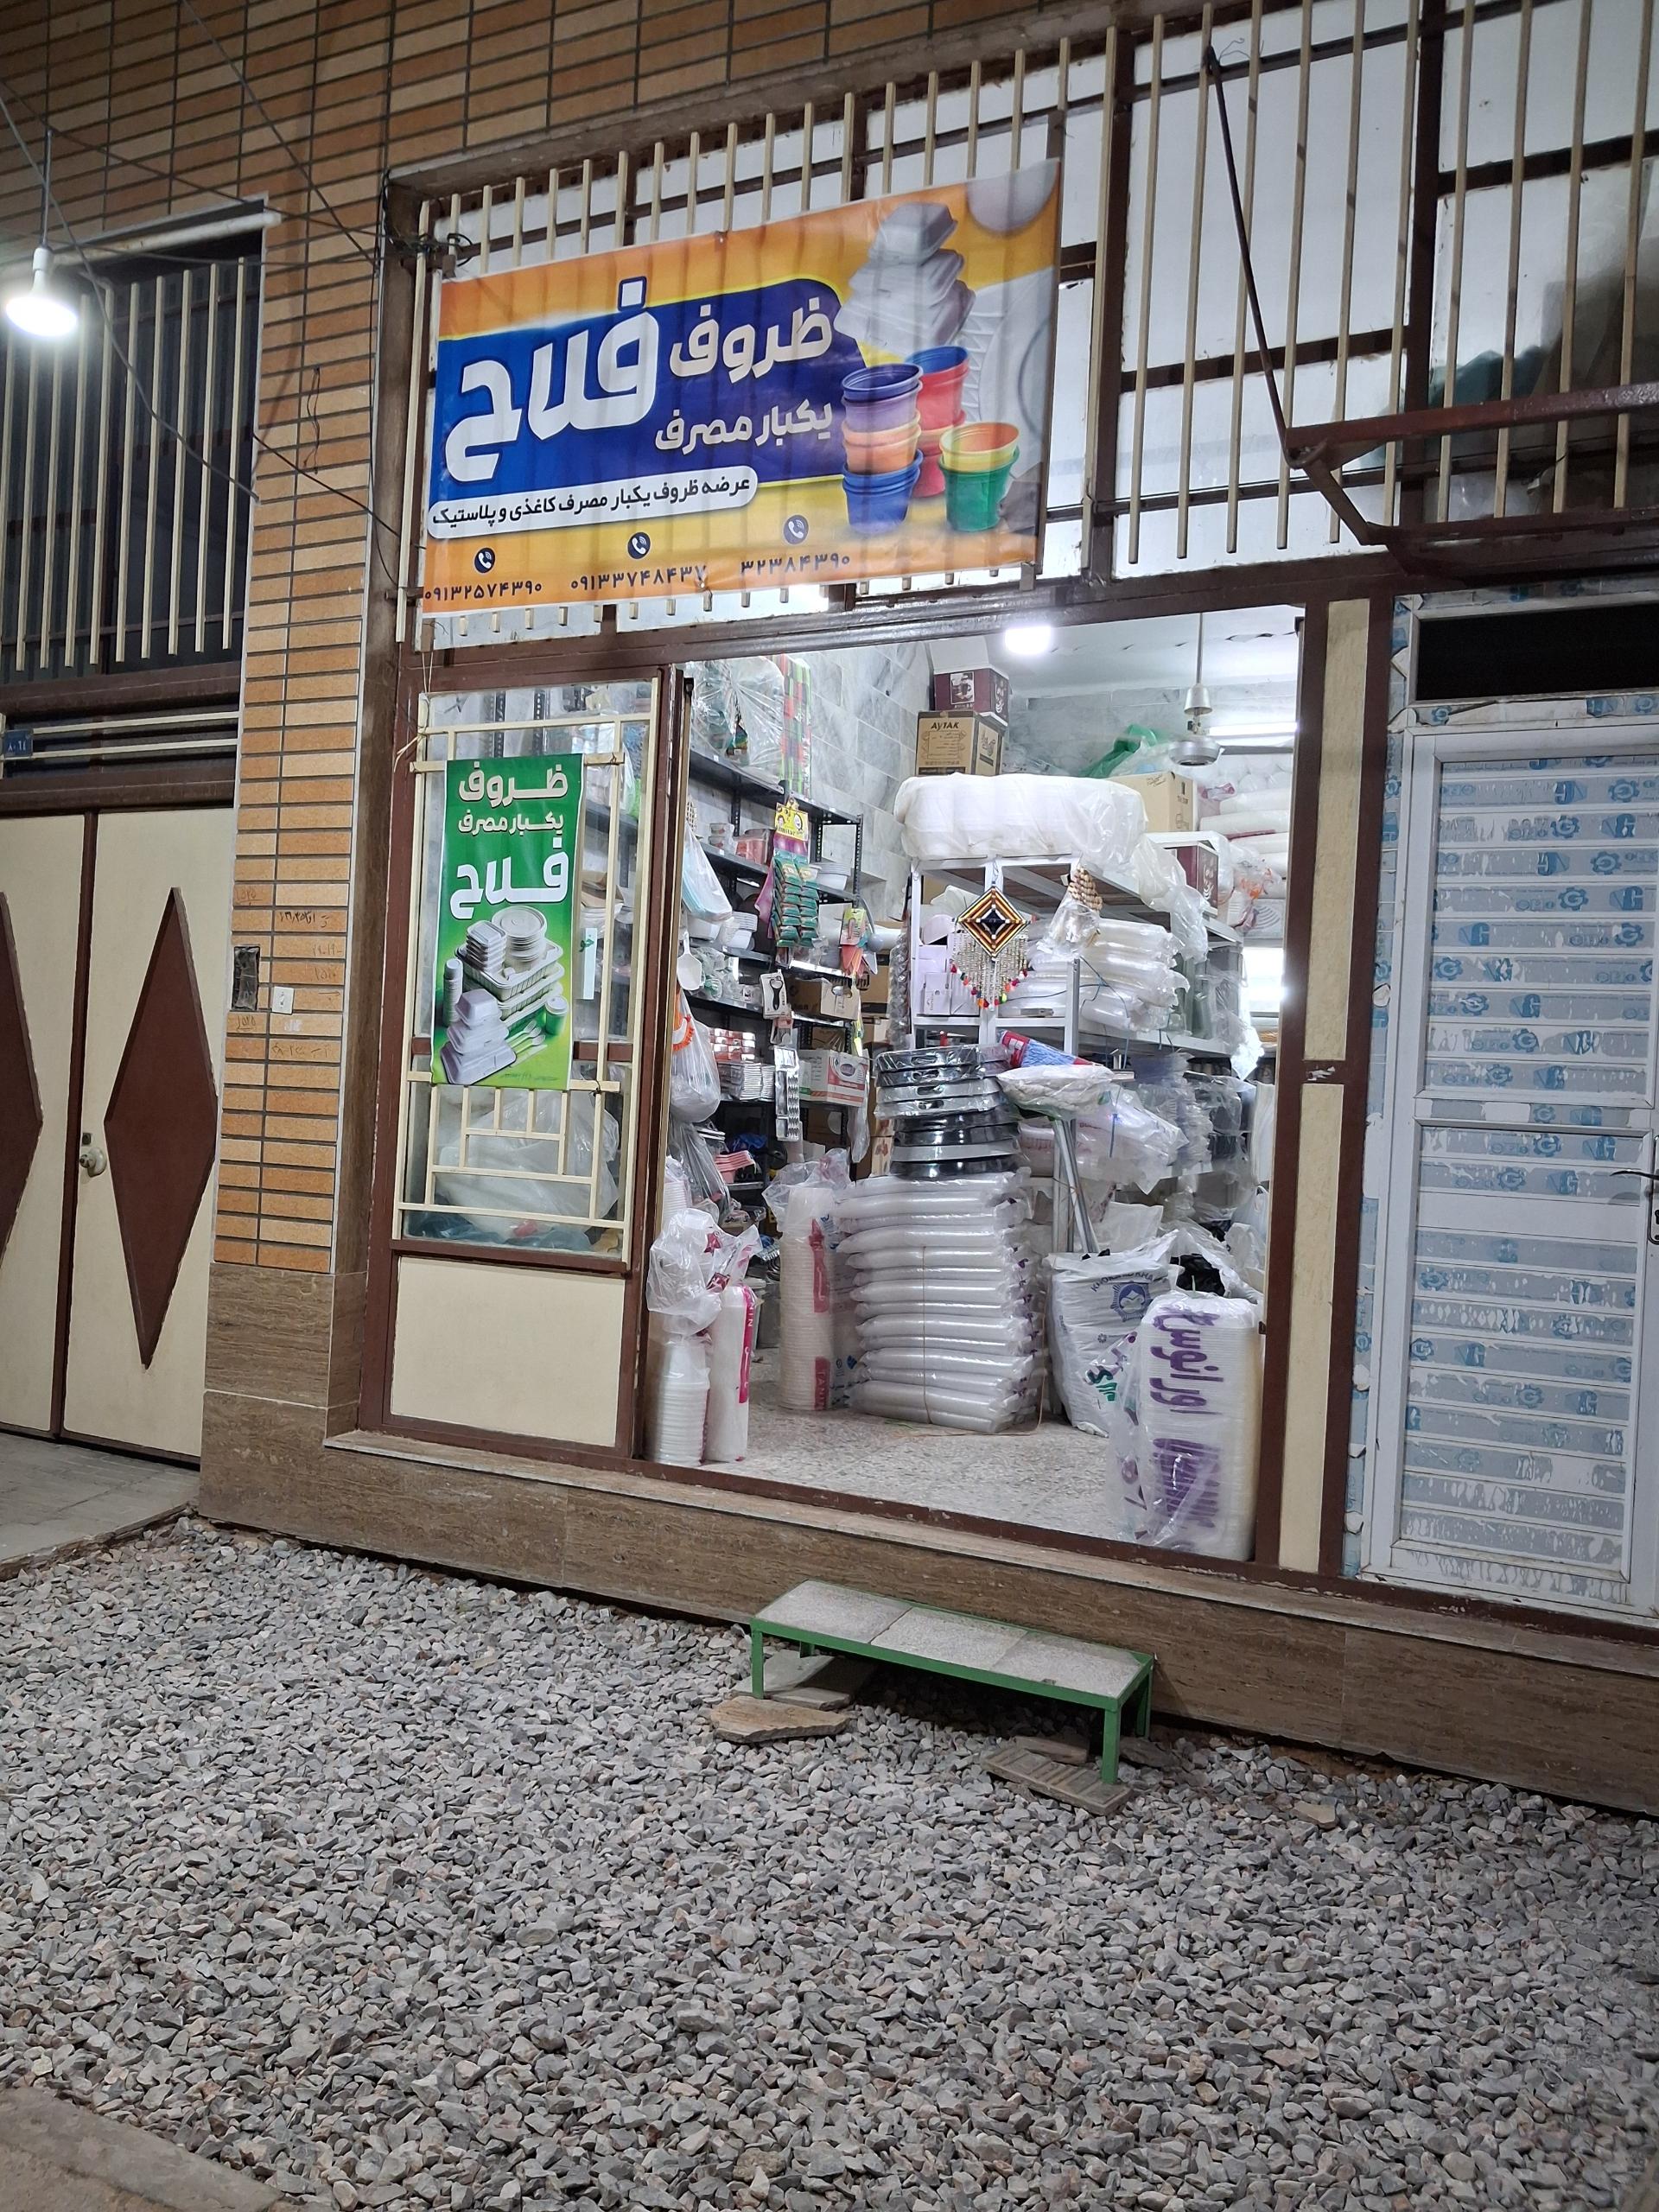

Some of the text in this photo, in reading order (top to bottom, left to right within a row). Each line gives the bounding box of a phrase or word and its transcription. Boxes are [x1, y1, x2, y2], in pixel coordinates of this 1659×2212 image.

[670, 297, 832, 384] ظروف
[444, 277, 659, 482] فلاح
[655, 398, 833, 455] یکبار مصرف
[432, 476, 750, 528] عرضه ظروف یکبار مصرف کاغذی و پلاستیک
[740, 552, 850, 576] ۳۲۳۸۴۳۹۰
[424, 580, 543, 601] ۰۹۱۳۲۵۷۴۳۹۰
[459, 761, 569, 808] ظروف
[458, 809, 564, 836] یکبار مصرف
[449, 836, 569, 919] فلاح
